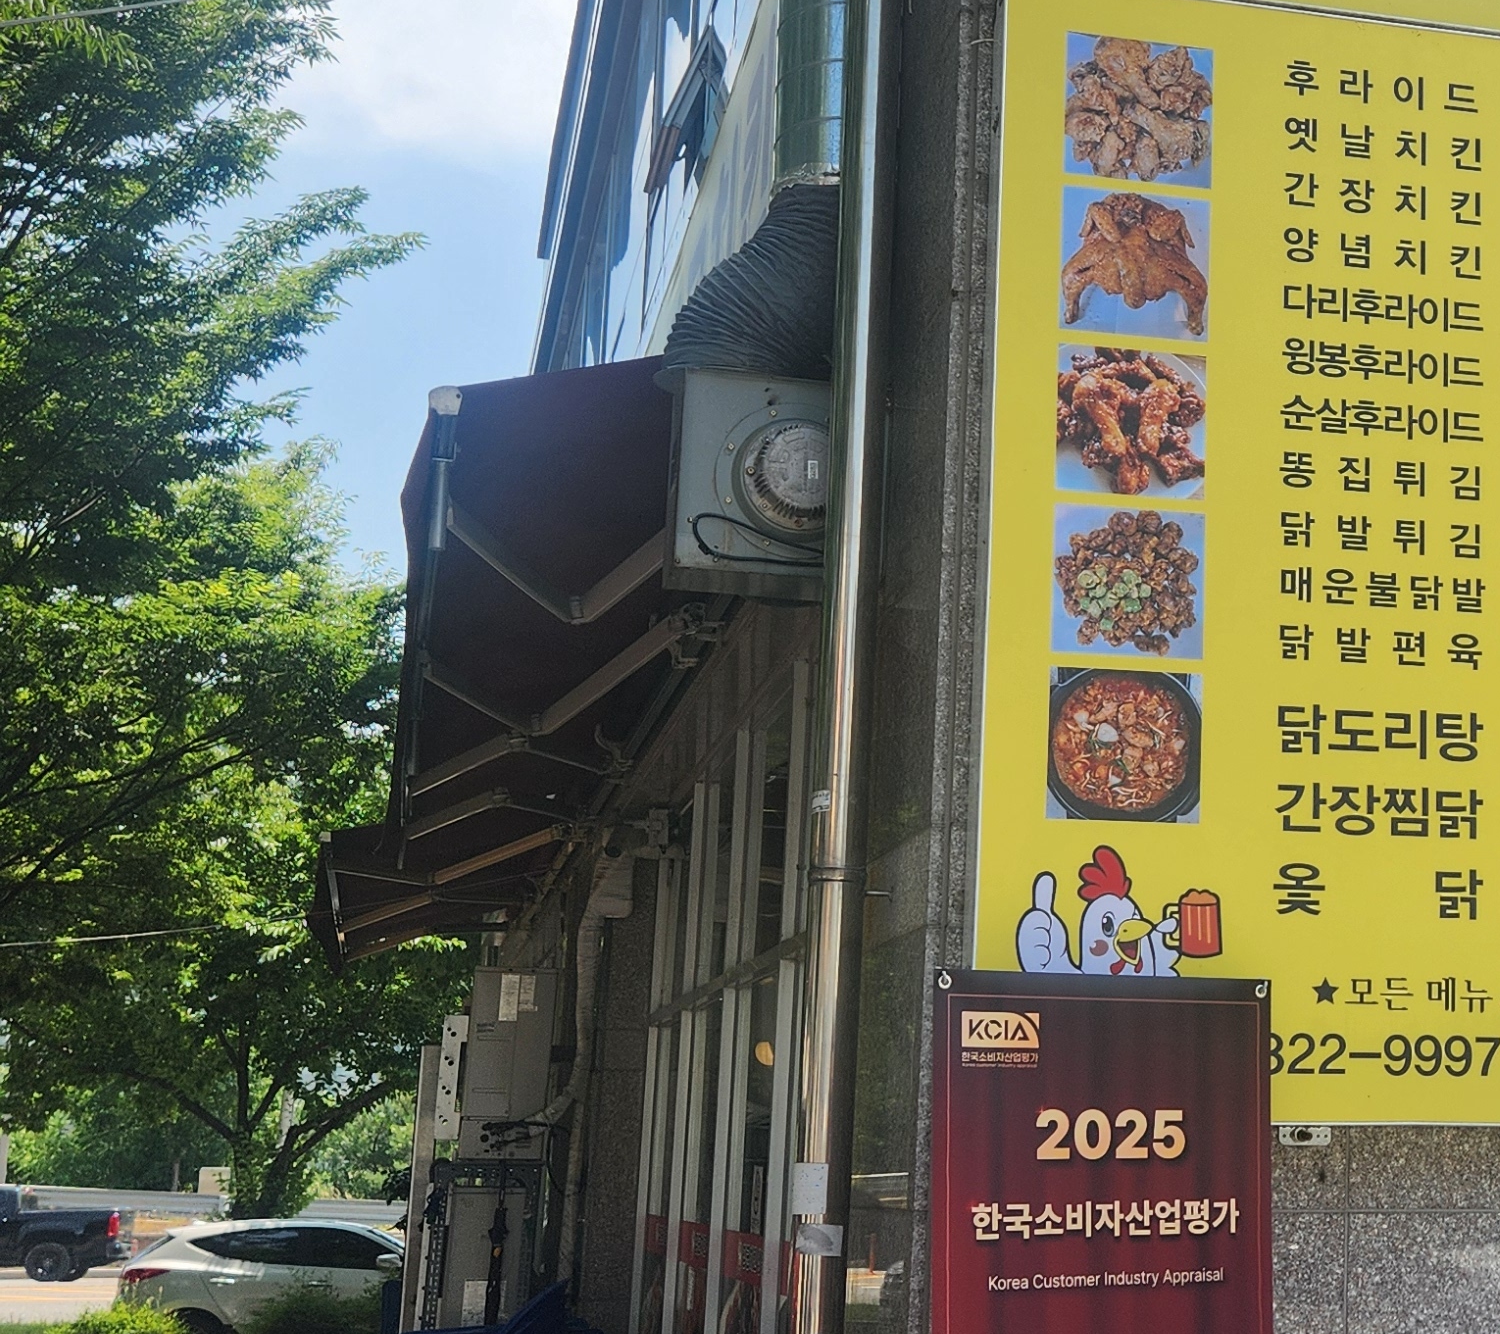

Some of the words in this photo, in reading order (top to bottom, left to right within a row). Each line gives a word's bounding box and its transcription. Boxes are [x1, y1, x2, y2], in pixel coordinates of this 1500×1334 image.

[1282, 283, 1484, 332] 다리후라이드
[1281, 337, 1484, 387] 윙봉후라이드
[1279, 394, 1484, 443] 순살후라이드
[1279, 566, 1486, 614] 매운불닭발
[1276, 703, 1484, 762] 닭도리탕
[1273, 782, 1484, 840] 간장찜닭
[1344, 978, 1414, 1011] 모든
[1426, 977, 1494, 1014] 메뉴
[969, 1019, 1030, 1041] KCIA
[1035, 1108, 1187, 1160] 2025
[971, 1198, 1241, 1241] 한국소비자산업평가
[988, 1274, 1029, 1291] Korea
[1032, 1271, 1101, 1289] Customer
[1103, 1269, 1160, 1289] Industry
[1162, 1266, 1225, 1287] Appraisal
